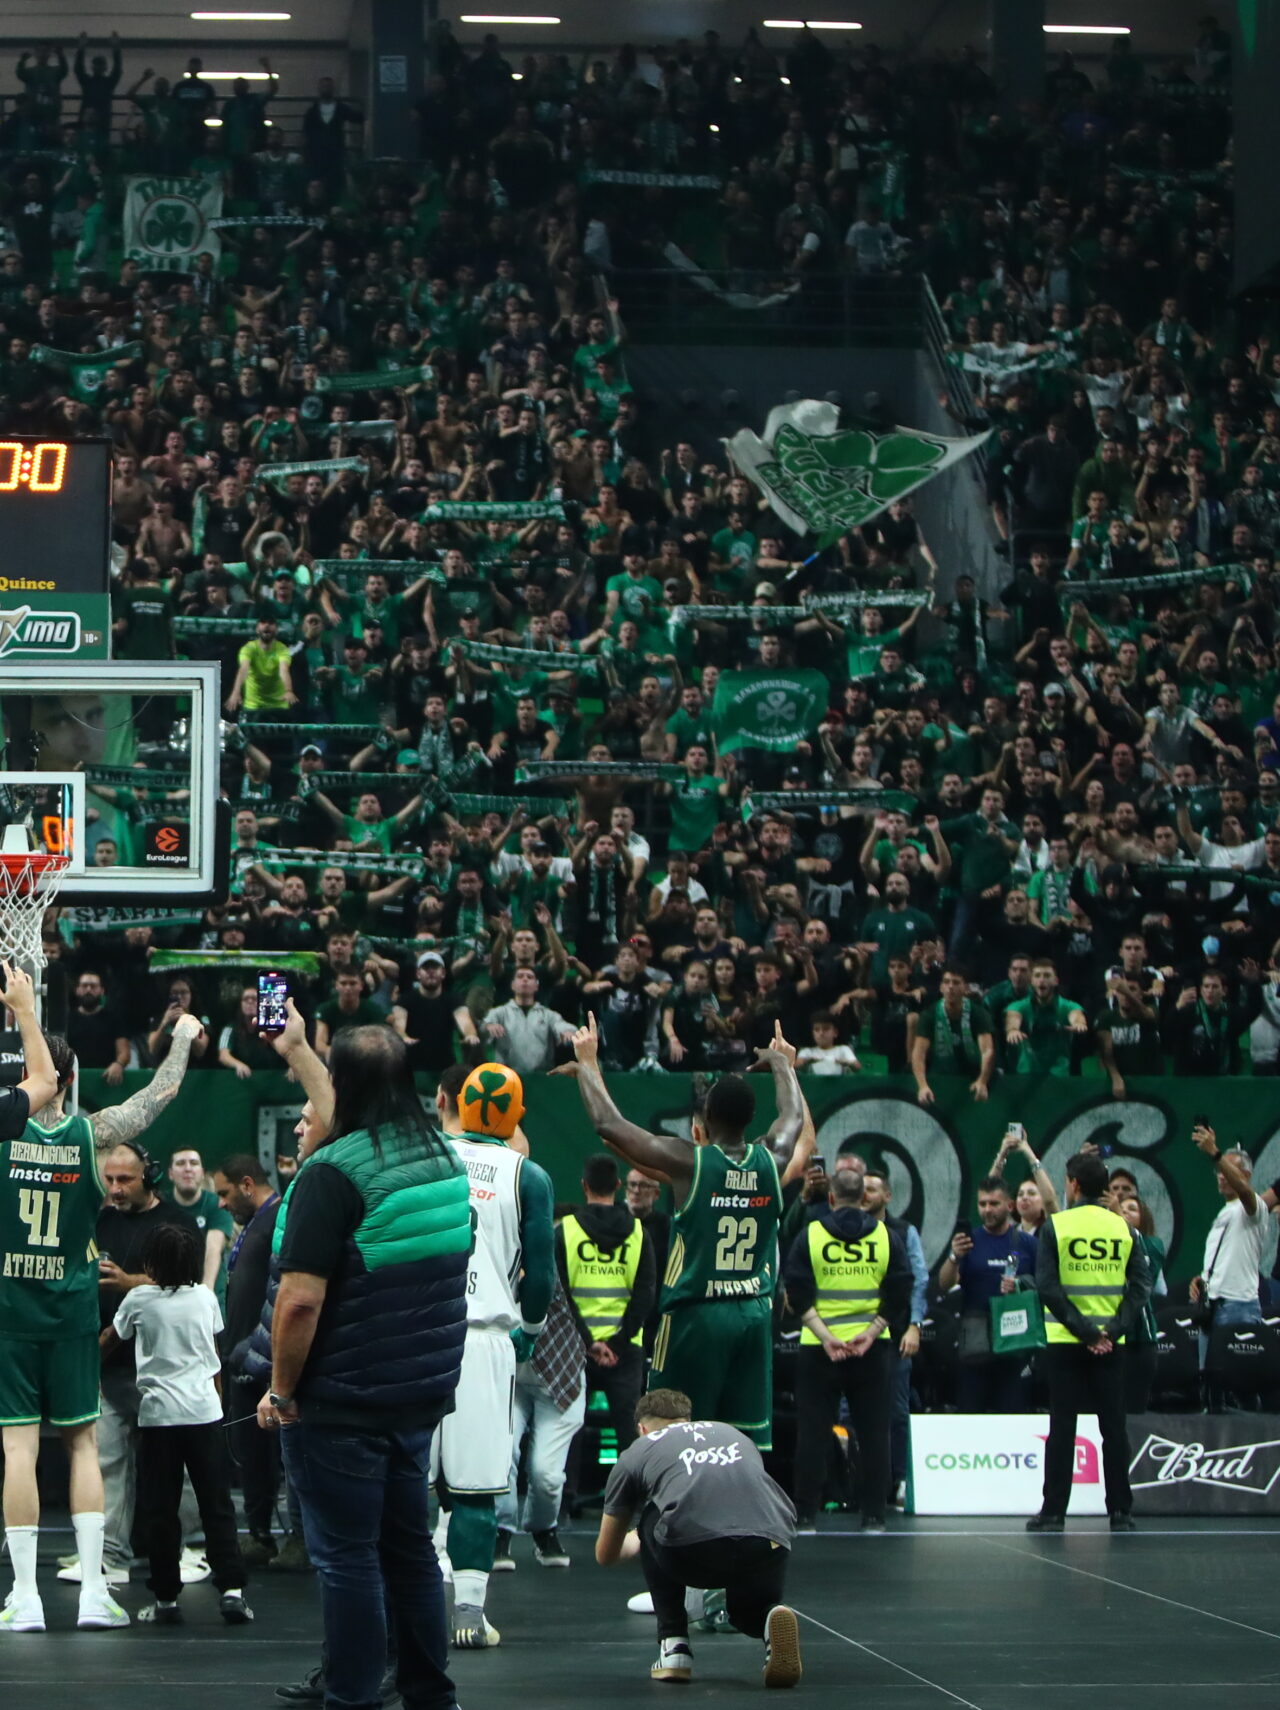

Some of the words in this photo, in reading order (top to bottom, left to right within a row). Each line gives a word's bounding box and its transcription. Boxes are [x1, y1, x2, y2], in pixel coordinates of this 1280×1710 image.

[85, 633, 99, 643] 18+
[146, 854, 188, 863] EuroLeague
[9, 1141, 80, 1166] HERNANGOMEZ
[9, 1164, 81, 1184] instacar
[464, 1160, 498, 1184] REEN
[725, 1169, 758, 1191] GRANT
[710, 1191, 772, 1209] instacar
[18, 1188, 61, 1247] 41
[715, 1215, 758, 1271] 22
[821, 1241, 878, 1263] CSI
[1068, 1238, 1123, 1261] CSI
[3, 1252, 65, 1280] ATHENS
[822, 1266, 878, 1276] SECURITY
[1068, 1262, 1121, 1272] SECURITY
[1227, 1343, 1265, 1351] AKTINA
[679, 1441, 742, 1476] POSSE
[925, 1453, 1038, 1471] COSMOTE
[1150, 1442, 1254, 1481] Bud
